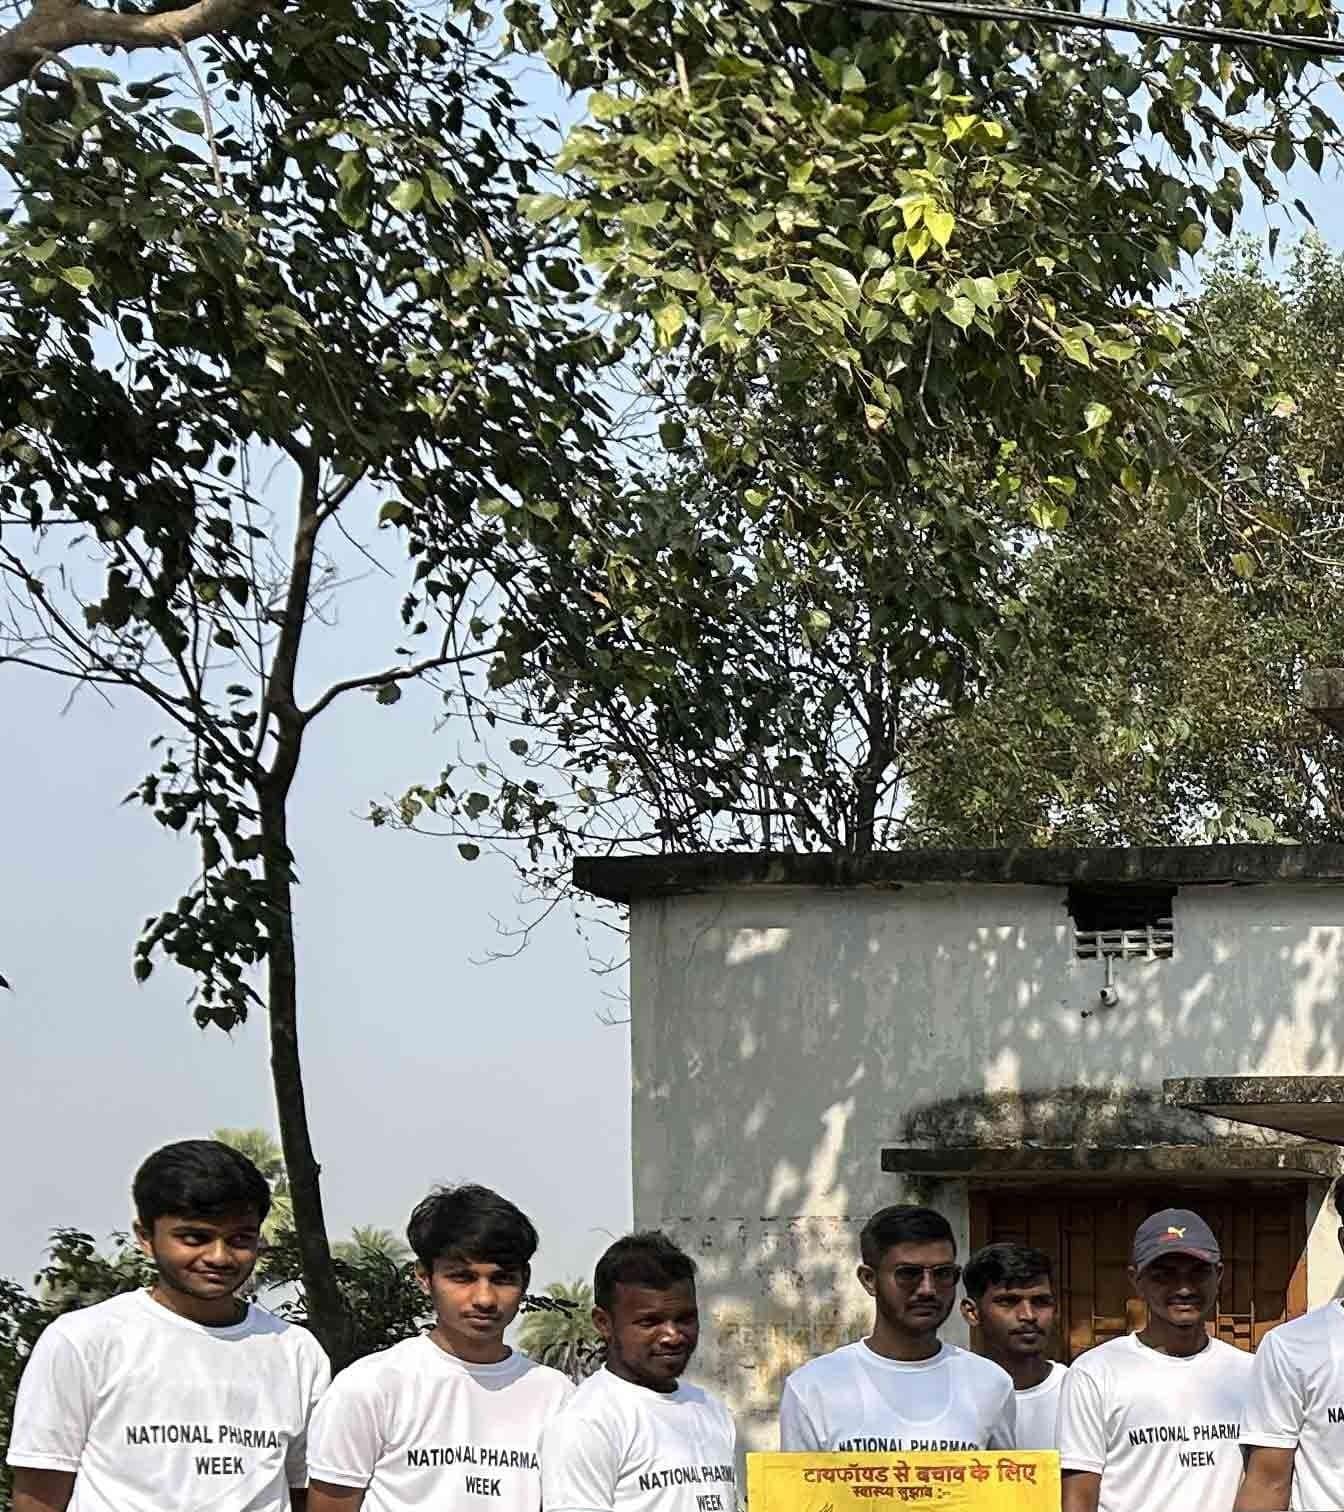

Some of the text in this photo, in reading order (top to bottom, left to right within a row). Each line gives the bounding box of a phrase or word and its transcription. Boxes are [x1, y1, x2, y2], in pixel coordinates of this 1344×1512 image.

[126, 1424, 283, 1449] NATIONAL PHARMA
[1129, 1425, 1189, 1446] NATIONAL
[195, 1456, 245, 1475] WEEK
[407, 1446, 540, 1470] NATIONAL PHARMA
[1178, 1450, 1215, 1468] WEEK
[639, 1468, 701, 1491] NATIONAL
[803, 1458, 1038, 1485] टायफॉयड से बचाव के लिए
[465, 1475, 502, 1497] WEEK
[696, 1493, 724, 1512] WEEK
